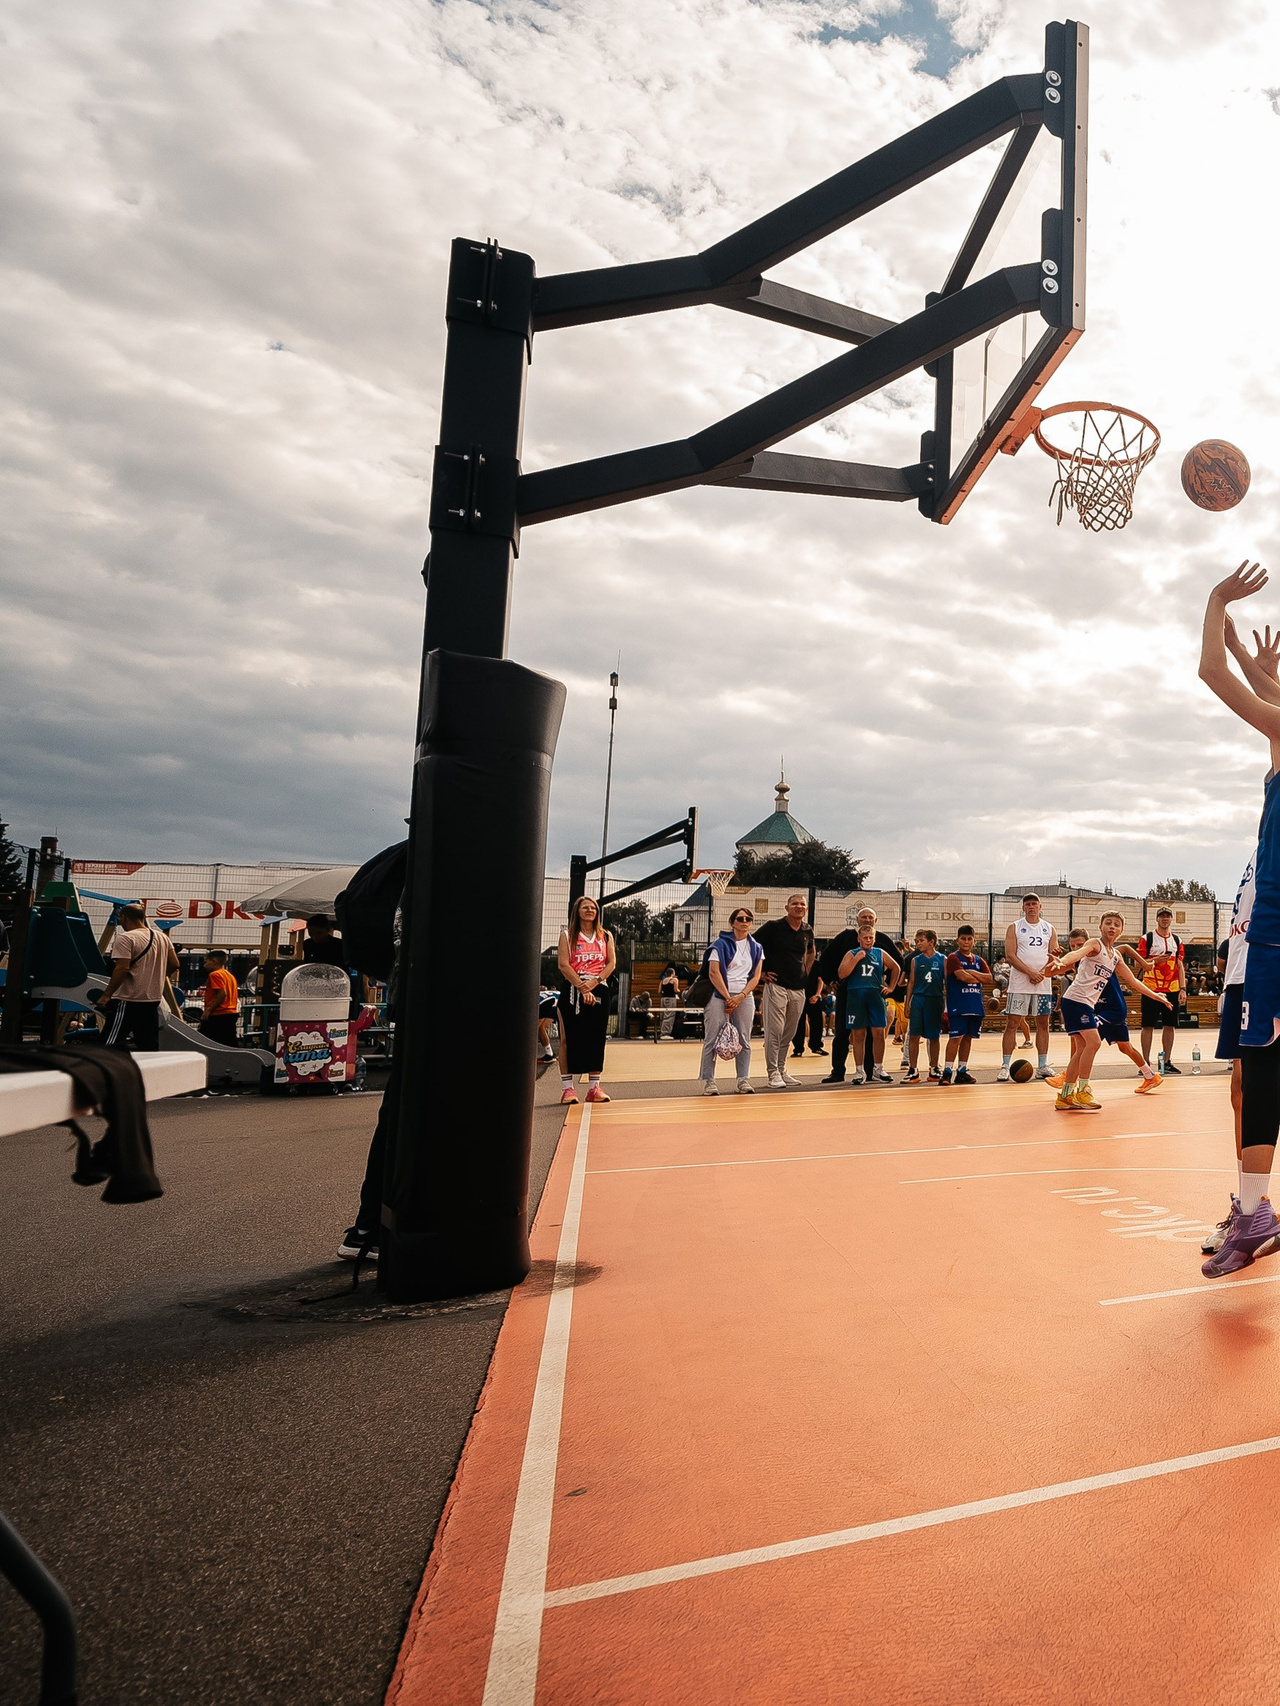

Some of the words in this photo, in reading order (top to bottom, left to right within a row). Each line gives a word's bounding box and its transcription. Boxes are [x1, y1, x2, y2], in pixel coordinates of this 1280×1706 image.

[188, 899, 267, 920] DK
[940, 912, 973, 921] DKC
[1028, 936, 1043, 947] 23
[575, 953, 605, 963] ТВЕРЬ
[861, 964, 875, 977] 17
[924, 971, 933, 983] 4
[847, 1014, 856, 1025] 17
